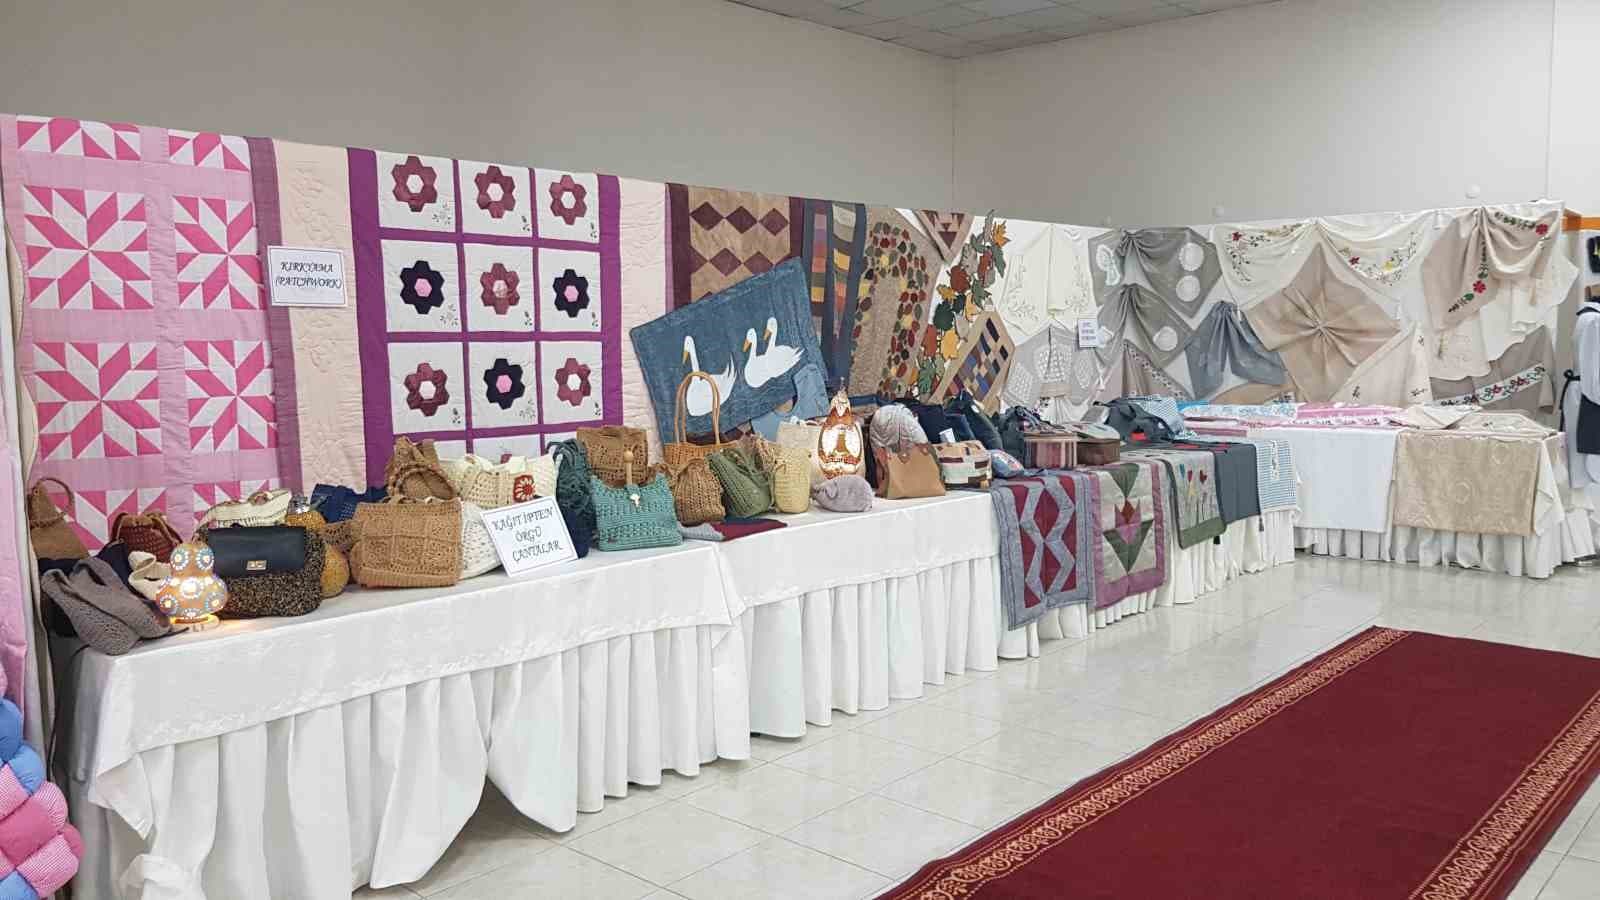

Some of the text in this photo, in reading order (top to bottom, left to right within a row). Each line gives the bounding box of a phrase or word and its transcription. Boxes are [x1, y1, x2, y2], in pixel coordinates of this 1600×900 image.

[275, 276, 342, 289] (PATCHWORK)
[492, 513, 522, 531] KAĞIT
[515, 526, 542, 543] ÖRGÜ
[512, 540, 563, 563] ÇANTALAR
